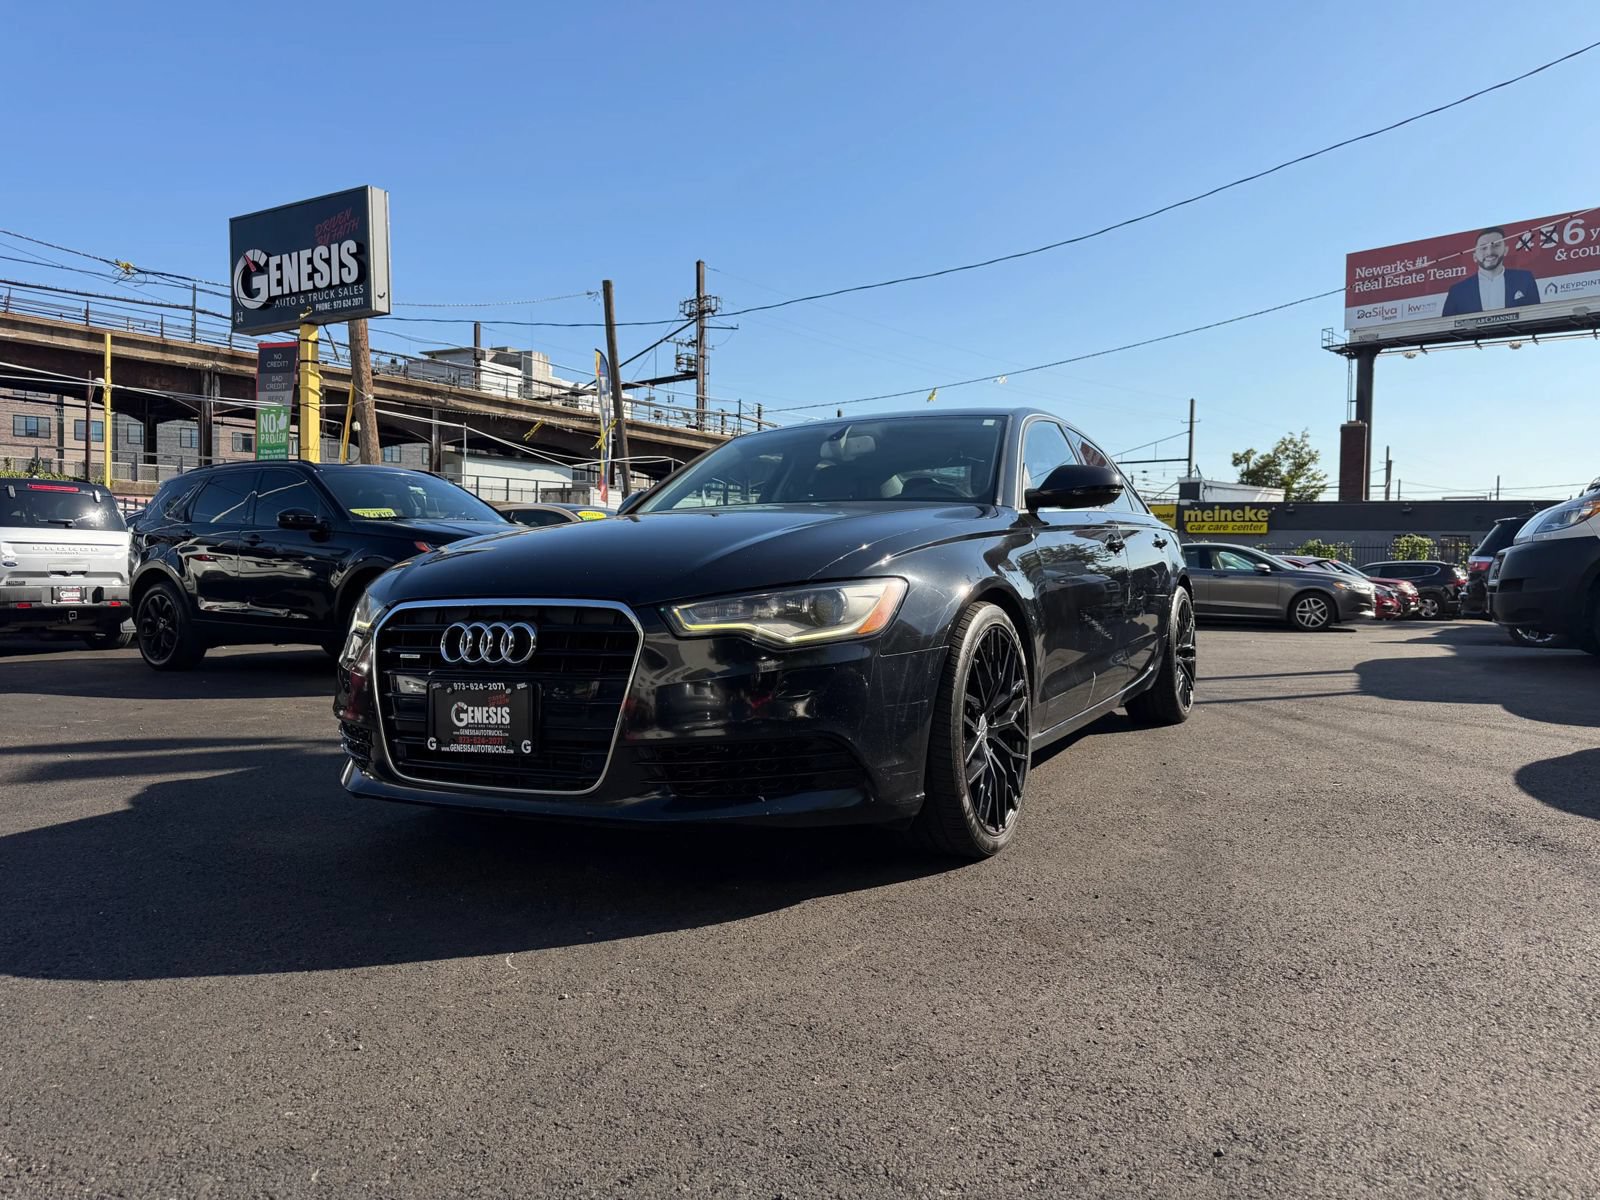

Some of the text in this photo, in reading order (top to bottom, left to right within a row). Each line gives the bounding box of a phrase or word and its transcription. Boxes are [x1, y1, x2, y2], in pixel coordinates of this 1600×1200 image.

[316, 208, 352, 236] DRIVEN
[1563, 219, 1586, 246] 6
[1555, 249, 1568, 261] &
[234, 239, 359, 310] GENESIS
[1355, 256, 1429, 279] Newark's #1
[1354, 266, 1467, 293] Real Estate Team
[275, 284, 364, 309] AUTO & TRUCK SALES
[315, 301, 333, 312] PHONE:
[333, 299, 342, 309] 973
[1407, 304, 1421, 313] kw
[266, 360, 289, 368] CREDIT?
[260, 413, 277, 433] NO
[1184, 505, 1269, 522] meineke
[1189, 523, 1264, 531] car care center
[453, 682, 506, 690] 973-624-2071
[451, 702, 510, 727] GENESIS
